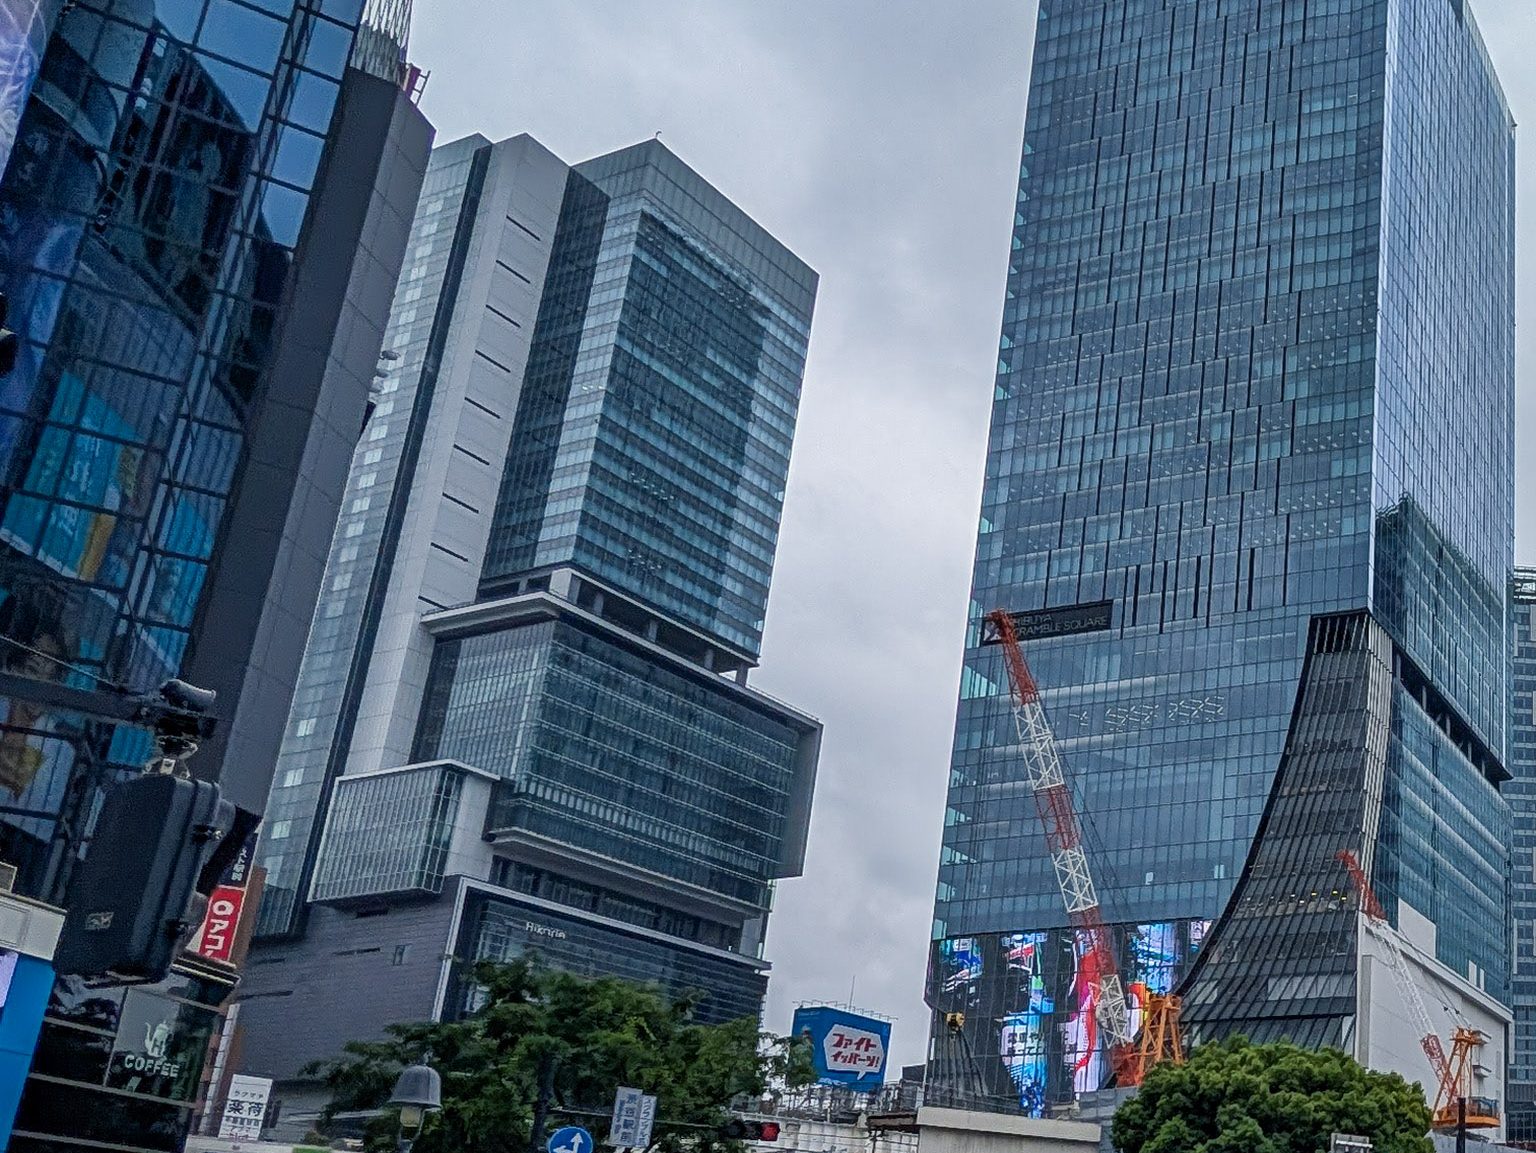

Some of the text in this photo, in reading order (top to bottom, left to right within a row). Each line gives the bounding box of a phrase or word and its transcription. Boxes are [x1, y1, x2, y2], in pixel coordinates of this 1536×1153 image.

[1012, 614, 1052, 628] HIBUYA
[832, 1033, 877, 1052] ファイト
[124, 1054, 181, 1079] COFFEE
